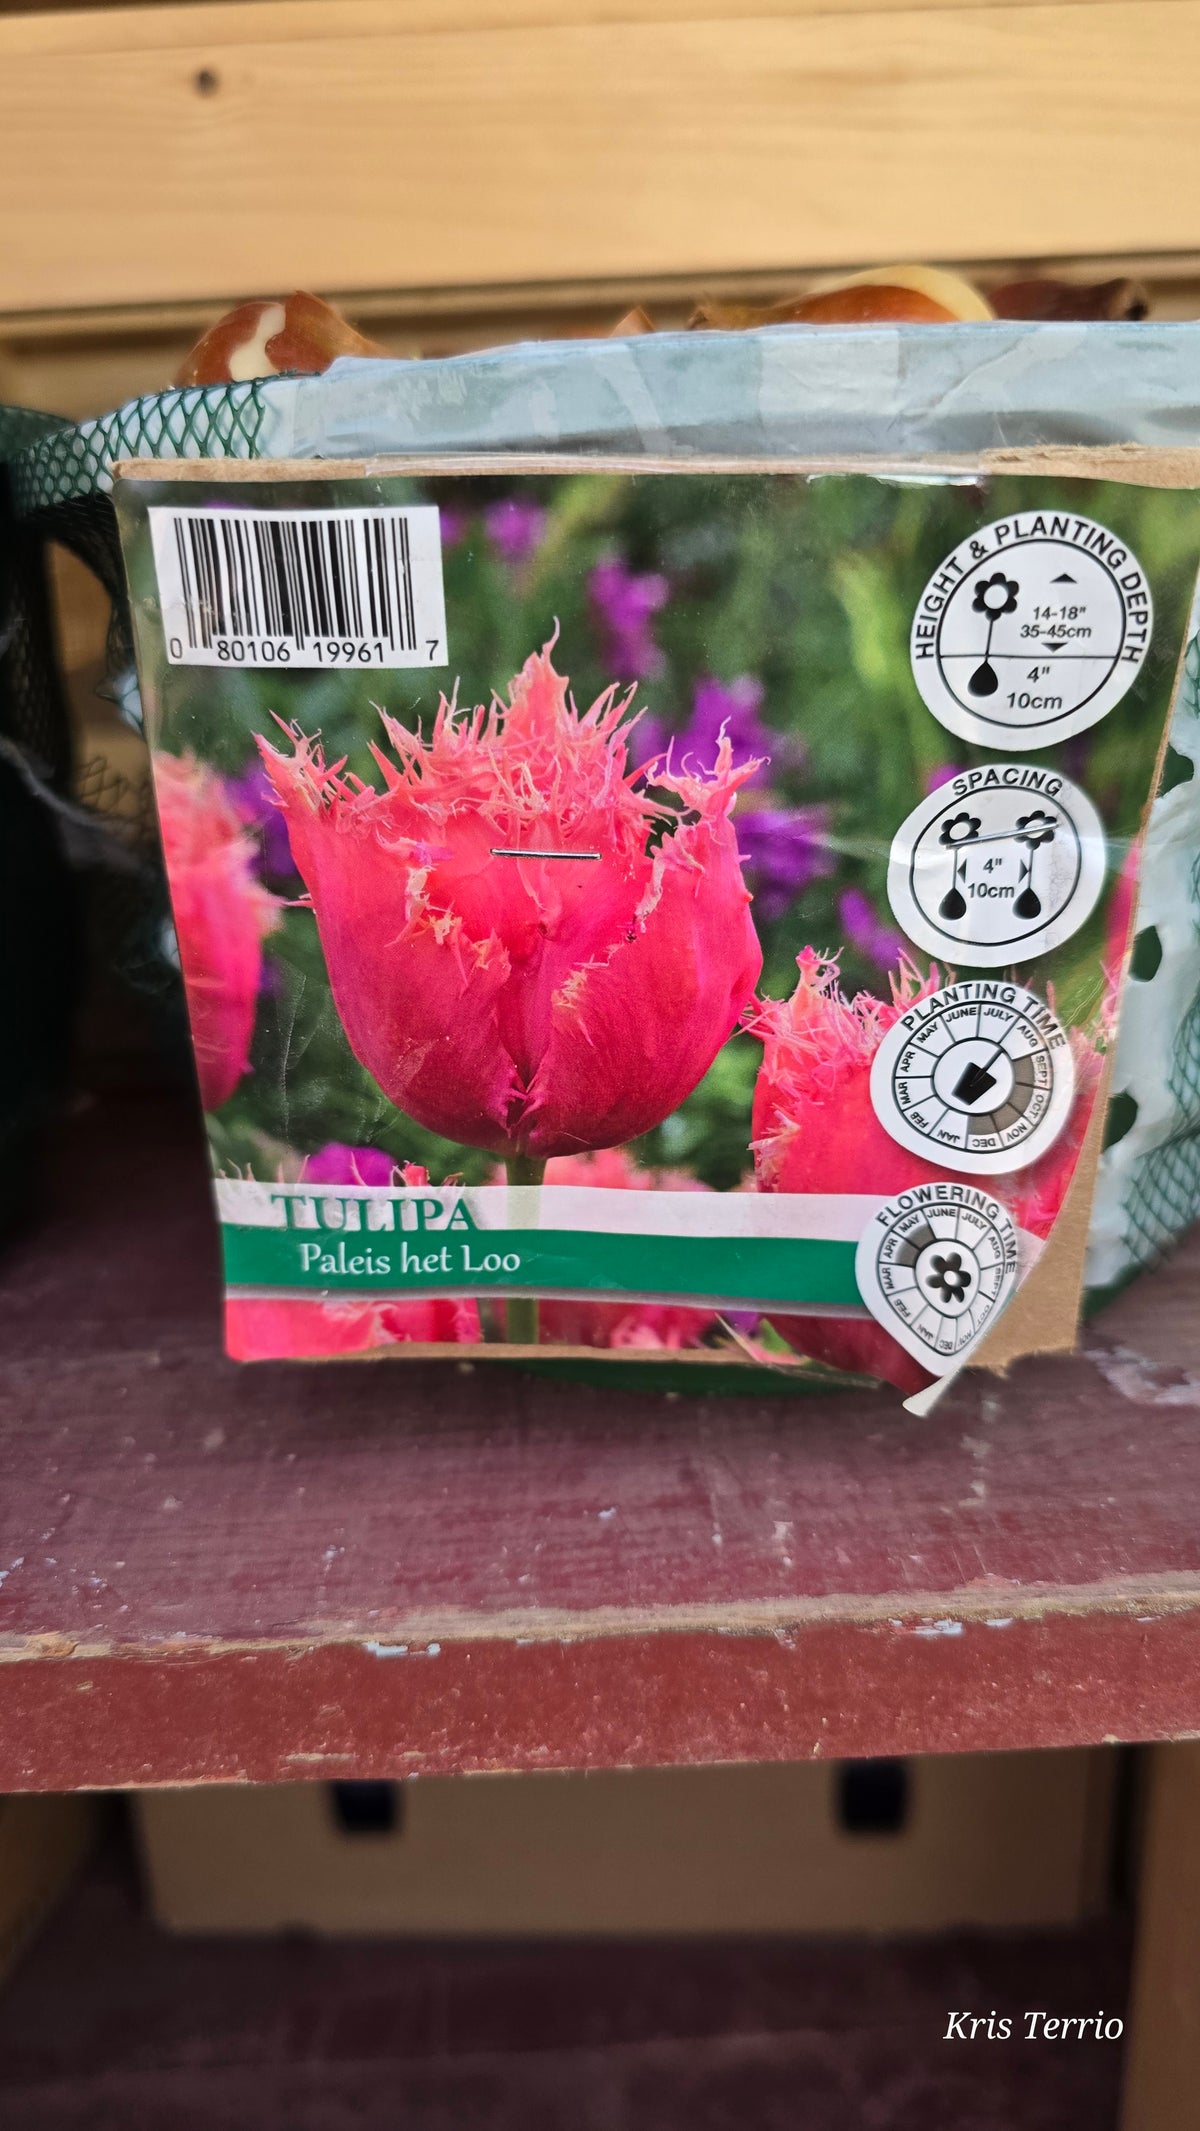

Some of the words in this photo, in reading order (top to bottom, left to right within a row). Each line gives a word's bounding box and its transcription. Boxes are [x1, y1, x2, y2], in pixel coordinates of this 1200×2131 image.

[915, 556, 965, 660] HEIGHT
[969, 540, 988, 560] &
[994, 515, 1128, 570] PLANTING
[1119, 571, 1149, 664] DEPTH
[1032, 605, 1087, 620] 14-18"
[1020, 624, 1092, 638] 35-45cm
[170, 637, 183, 659] 0
[217, 640, 291, 662] 80106
[313, 642, 385, 663] 19961
[425, 639, 439, 661] 7
[1026, 666, 1051, 683] 4"
[1006, 693, 1063, 710] 10cm
[952, 767, 1063, 797] SPACING
[983, 858, 1003, 874] 4"
[967, 883, 1015, 899] 10cm
[901, 983, 1016, 1032] PLANTING
[1021, 995, 1066, 1050] TIME
[946, 1006, 978, 1023] JUNE
[983, 1007, 1014, 1022] JULY
[916, 1021, 939, 1044] MAY
[1017, 1024, 1039, 1048] AUG
[900, 1050, 916, 1073] APR
[1035, 1055, 1048, 1087] SEPT
[899, 1081, 911, 1105] MAR
[1029, 1094, 1044, 1120] OCT
[910, 1111, 930, 1129] FEB
[937, 1128, 960, 1144] JAN
[972, 1137, 996, 1148] DEC
[1006, 1122, 1028, 1142] NOV
[270, 1194, 481, 1231] TULIPA
[898, 1214, 921, 1233] MAY
[926, 1208, 957, 1219] JUNE
[961, 1211, 988, 1230] JULY
[875, 1185, 1000, 1227] FLOWERING
[1000, 1218, 1018, 1274] TIME
[883, 1237, 899, 1259] APR
[988, 1235, 1001, 1259] AUG
[300, 1242, 391, 1275] Paleis
[400, 1242, 452, 1274] het
[461, 1245, 521, 1273] Loo
[882, 1267, 895, 1290] MAR
